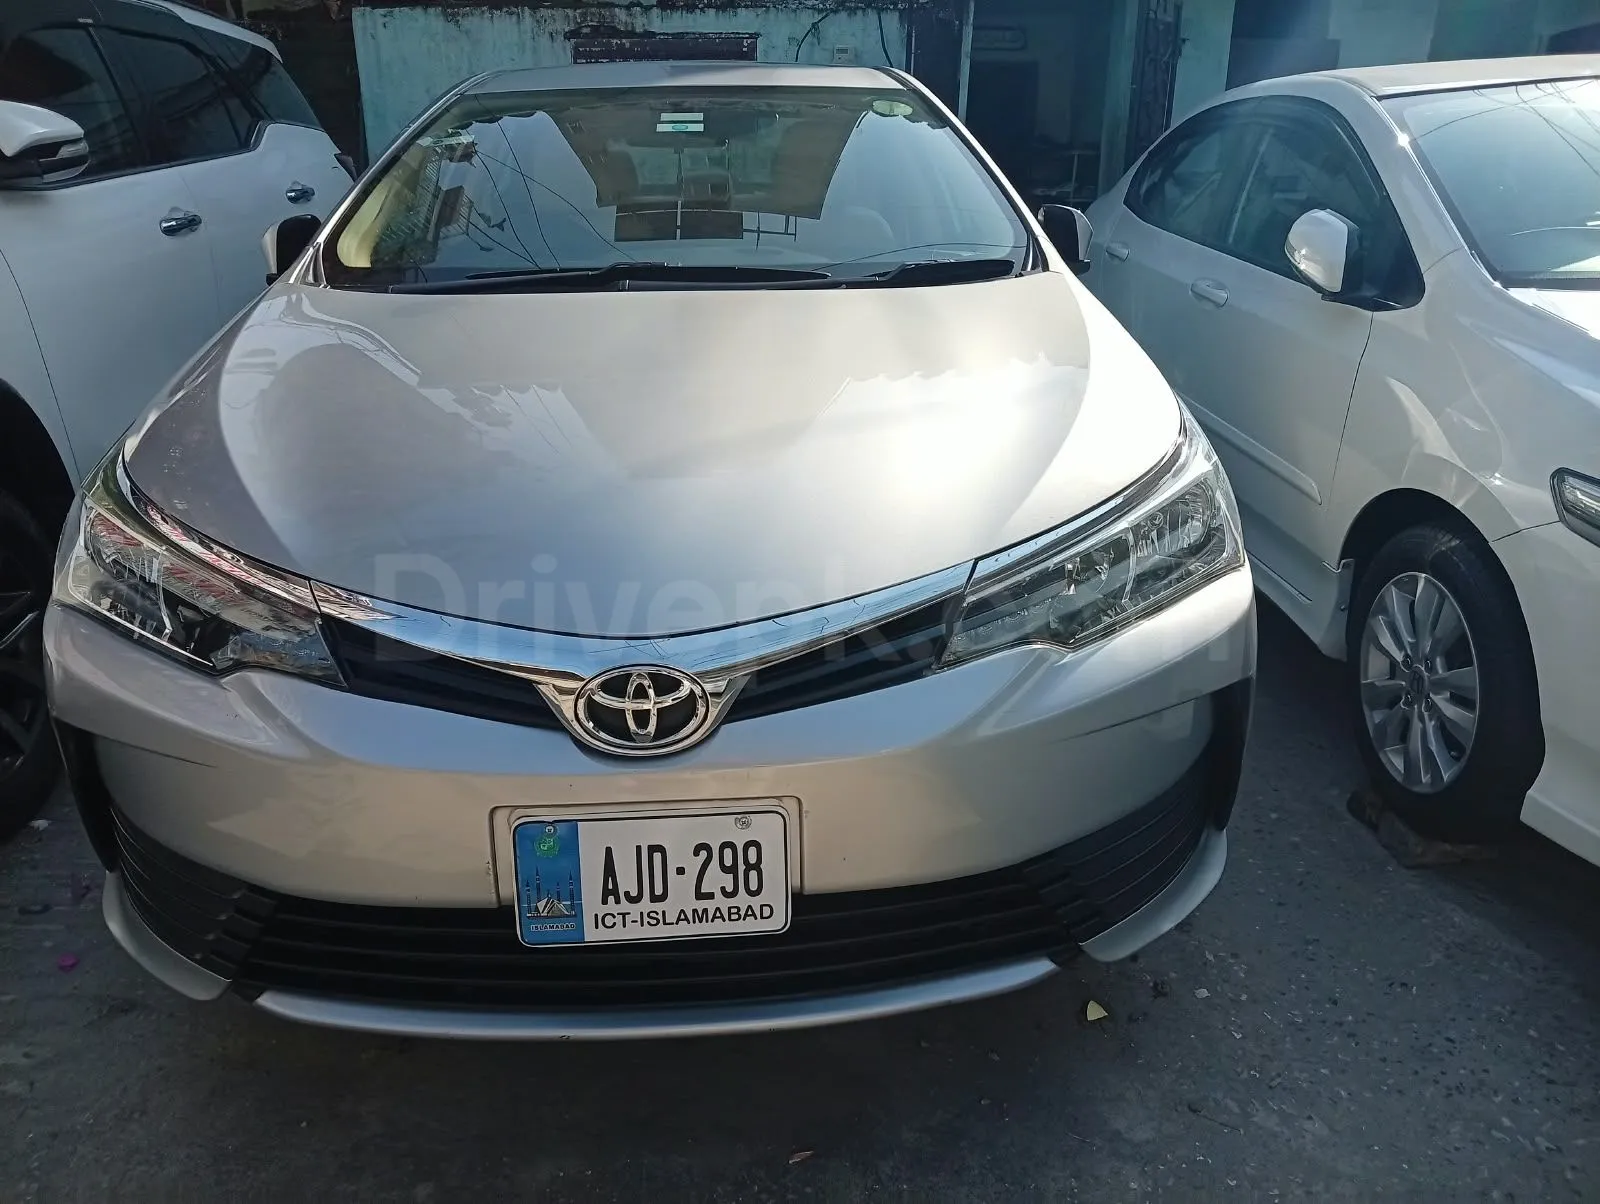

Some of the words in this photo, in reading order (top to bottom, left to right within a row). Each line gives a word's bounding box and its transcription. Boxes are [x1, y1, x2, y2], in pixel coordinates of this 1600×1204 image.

[601, 839, 764, 906] AJD-298
[530, 922, 576, 932] ISLAMABAD
[593, 903, 775, 930] ICT-ISLAMABAD
